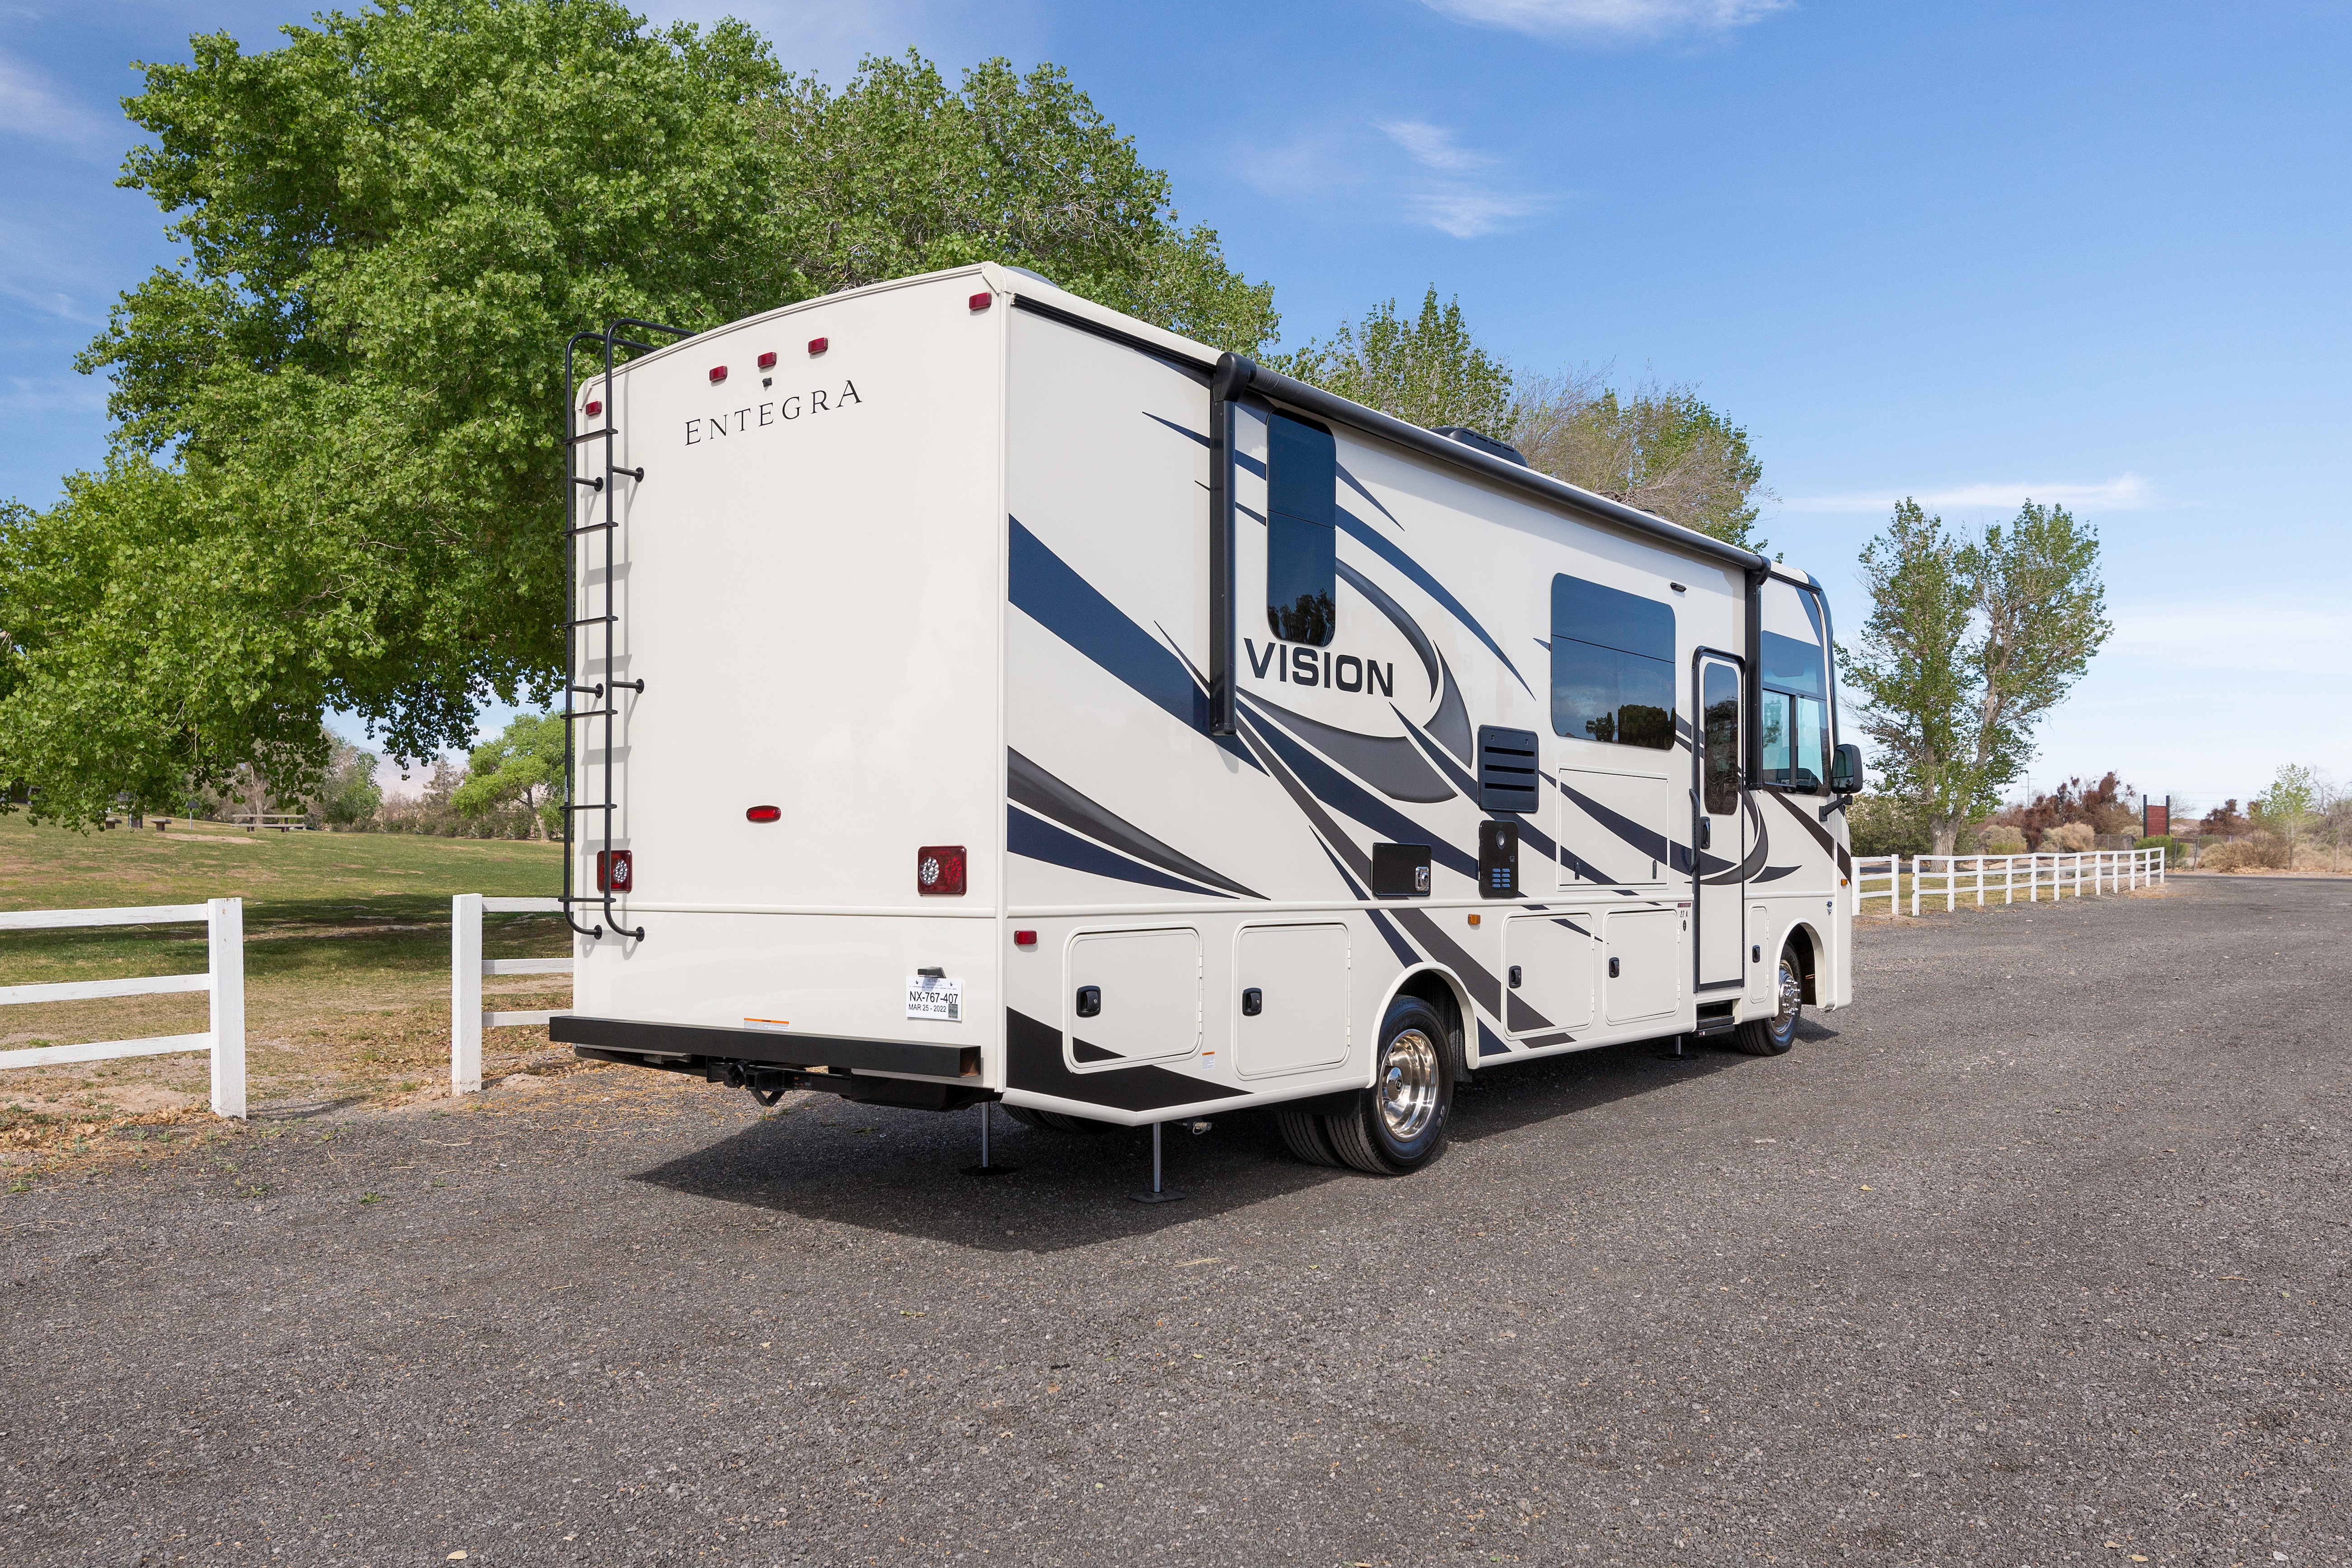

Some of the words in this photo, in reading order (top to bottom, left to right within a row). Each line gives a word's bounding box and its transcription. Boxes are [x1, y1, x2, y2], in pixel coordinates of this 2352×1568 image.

[684, 379, 863, 446] ENTEGRA
[1243, 637, 1393, 698] VISION
[910, 991, 958, 1004] NX-767-407
